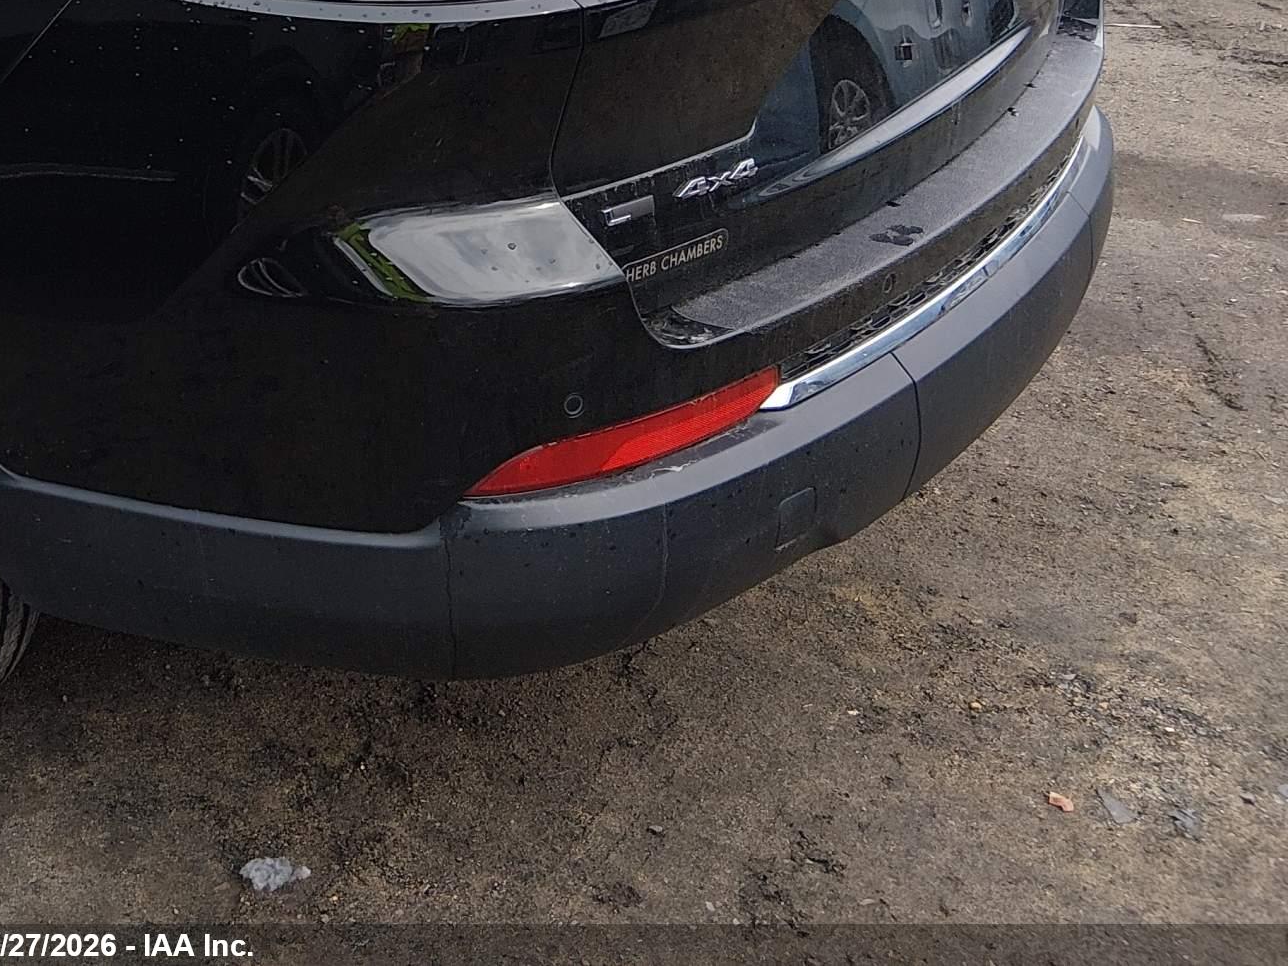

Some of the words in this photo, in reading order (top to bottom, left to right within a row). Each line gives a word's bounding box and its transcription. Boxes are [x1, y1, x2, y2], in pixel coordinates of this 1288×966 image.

[673, 157, 760, 201] 4x4
[625, 262, 657, 283] HERB
[661, 235, 724, 272] CHAMBERS
